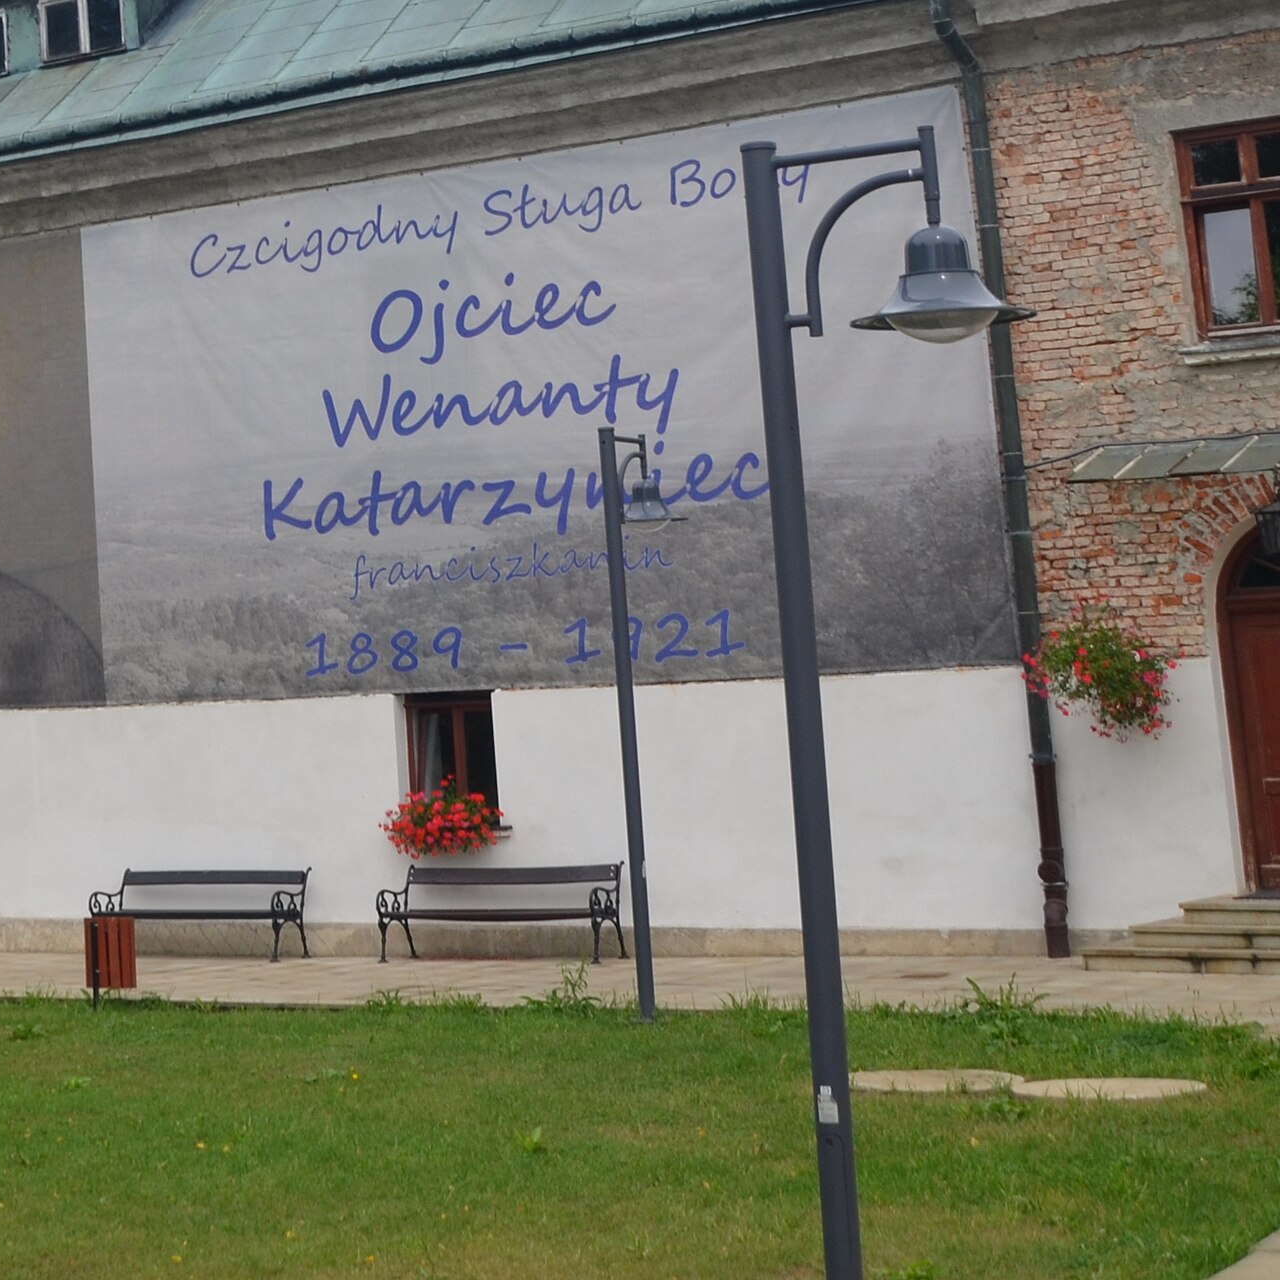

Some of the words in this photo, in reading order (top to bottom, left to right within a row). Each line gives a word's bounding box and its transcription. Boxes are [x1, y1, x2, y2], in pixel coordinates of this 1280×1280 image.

[190, 204, 458, 279] Czcigodny
[483, 179, 642, 233] Sługa
[669, 159, 810, 208] Boy
[369, 273, 617, 365] Ojciec
[322, 354, 680, 449] Wenanty
[305, 625, 462, 677] 1889
